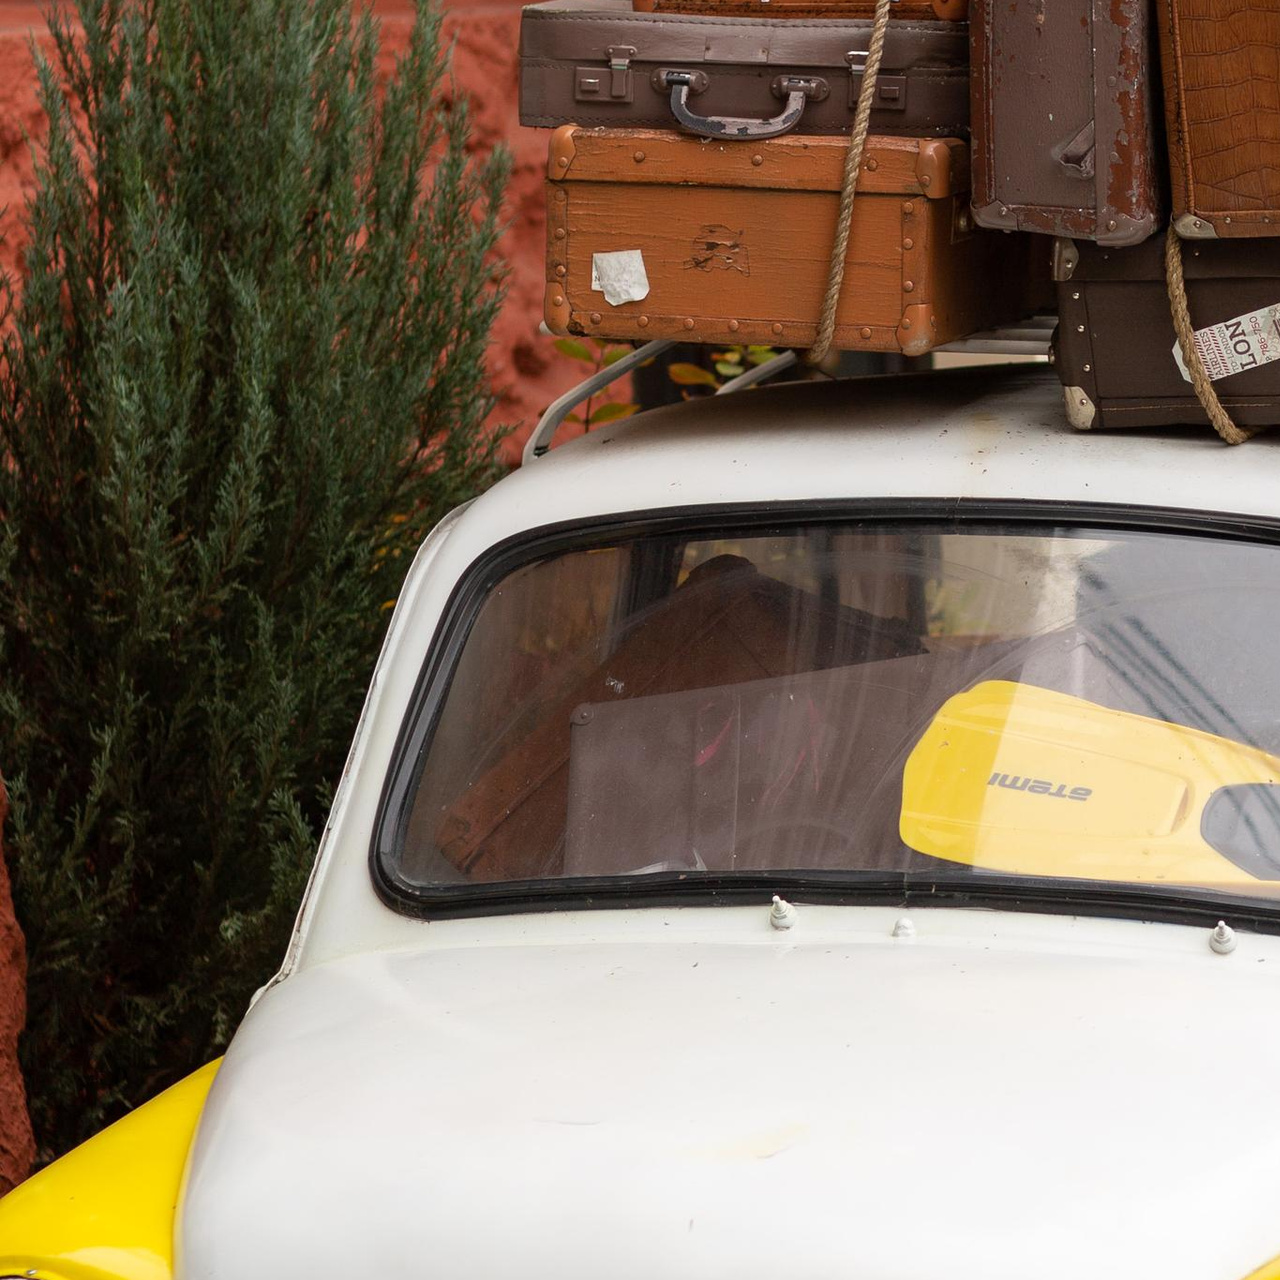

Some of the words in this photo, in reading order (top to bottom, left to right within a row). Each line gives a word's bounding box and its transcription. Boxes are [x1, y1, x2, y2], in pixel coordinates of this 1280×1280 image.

[1200, 331, 1225, 377] AIRLINES
[1224, 320, 1258, 370] LON
[1250, 316, 1270, 355] 786-750
